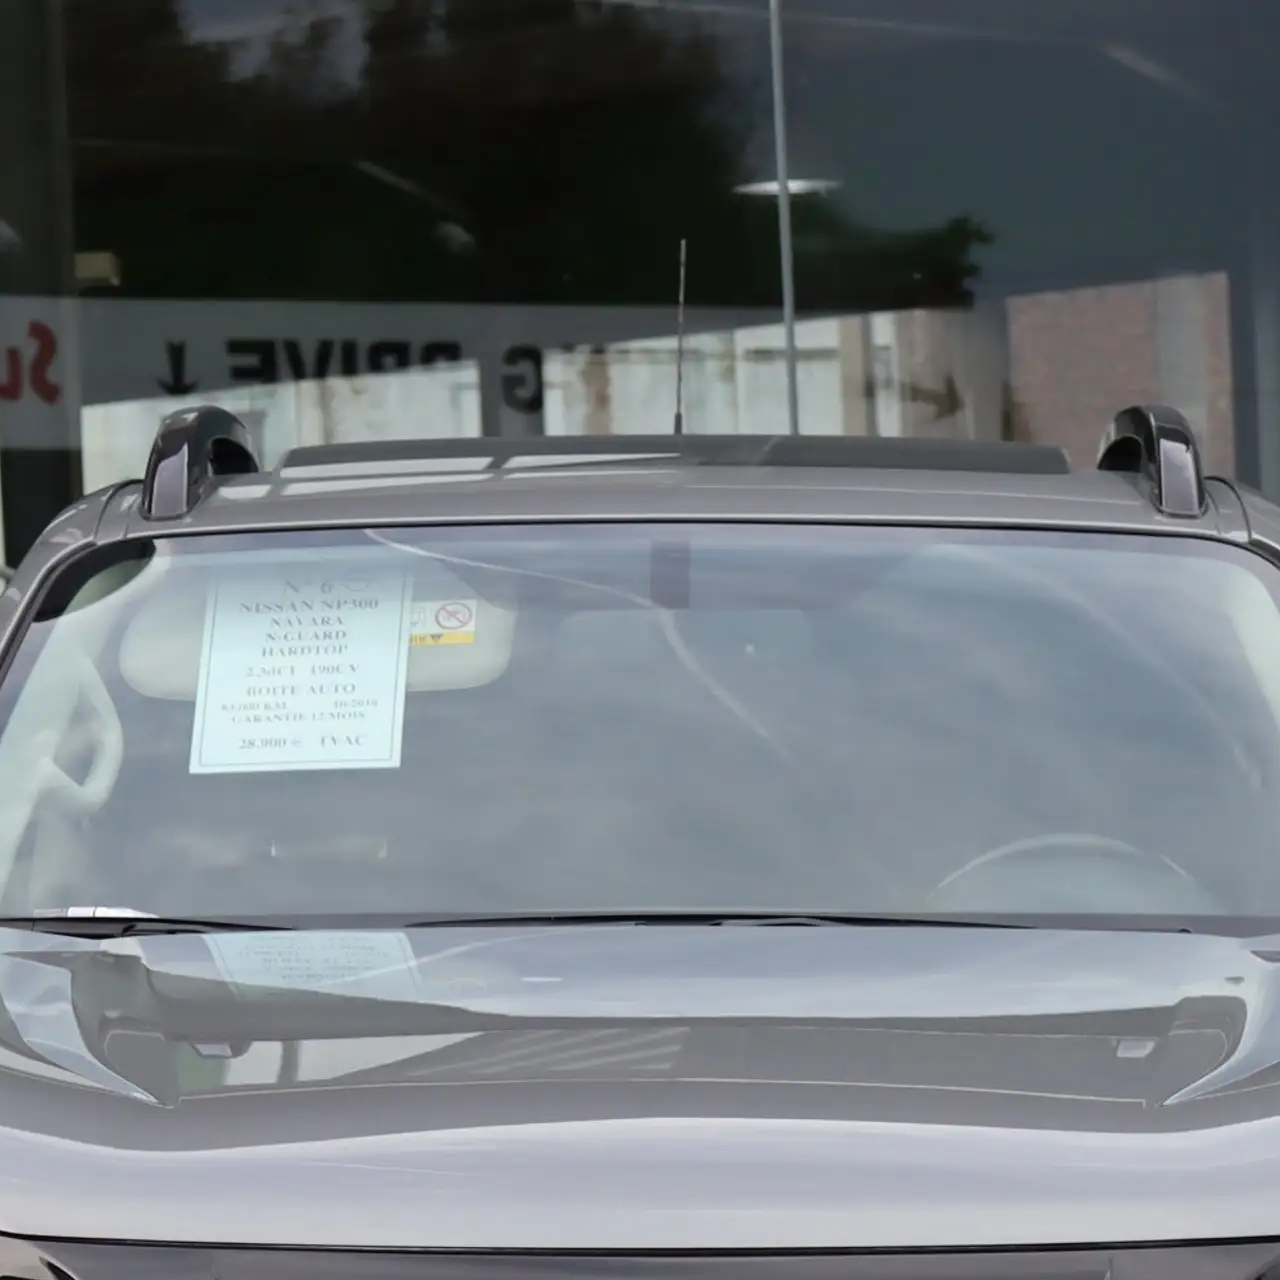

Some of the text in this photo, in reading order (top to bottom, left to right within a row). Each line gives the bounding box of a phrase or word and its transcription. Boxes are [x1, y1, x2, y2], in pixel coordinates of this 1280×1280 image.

[239, 597, 380, 614] NISSAN NP300
[270, 615, 345, 628] NAVARA
[261, 644, 349, 658] HARDTOP
[246, 682, 356, 697] BOITE AUTO
